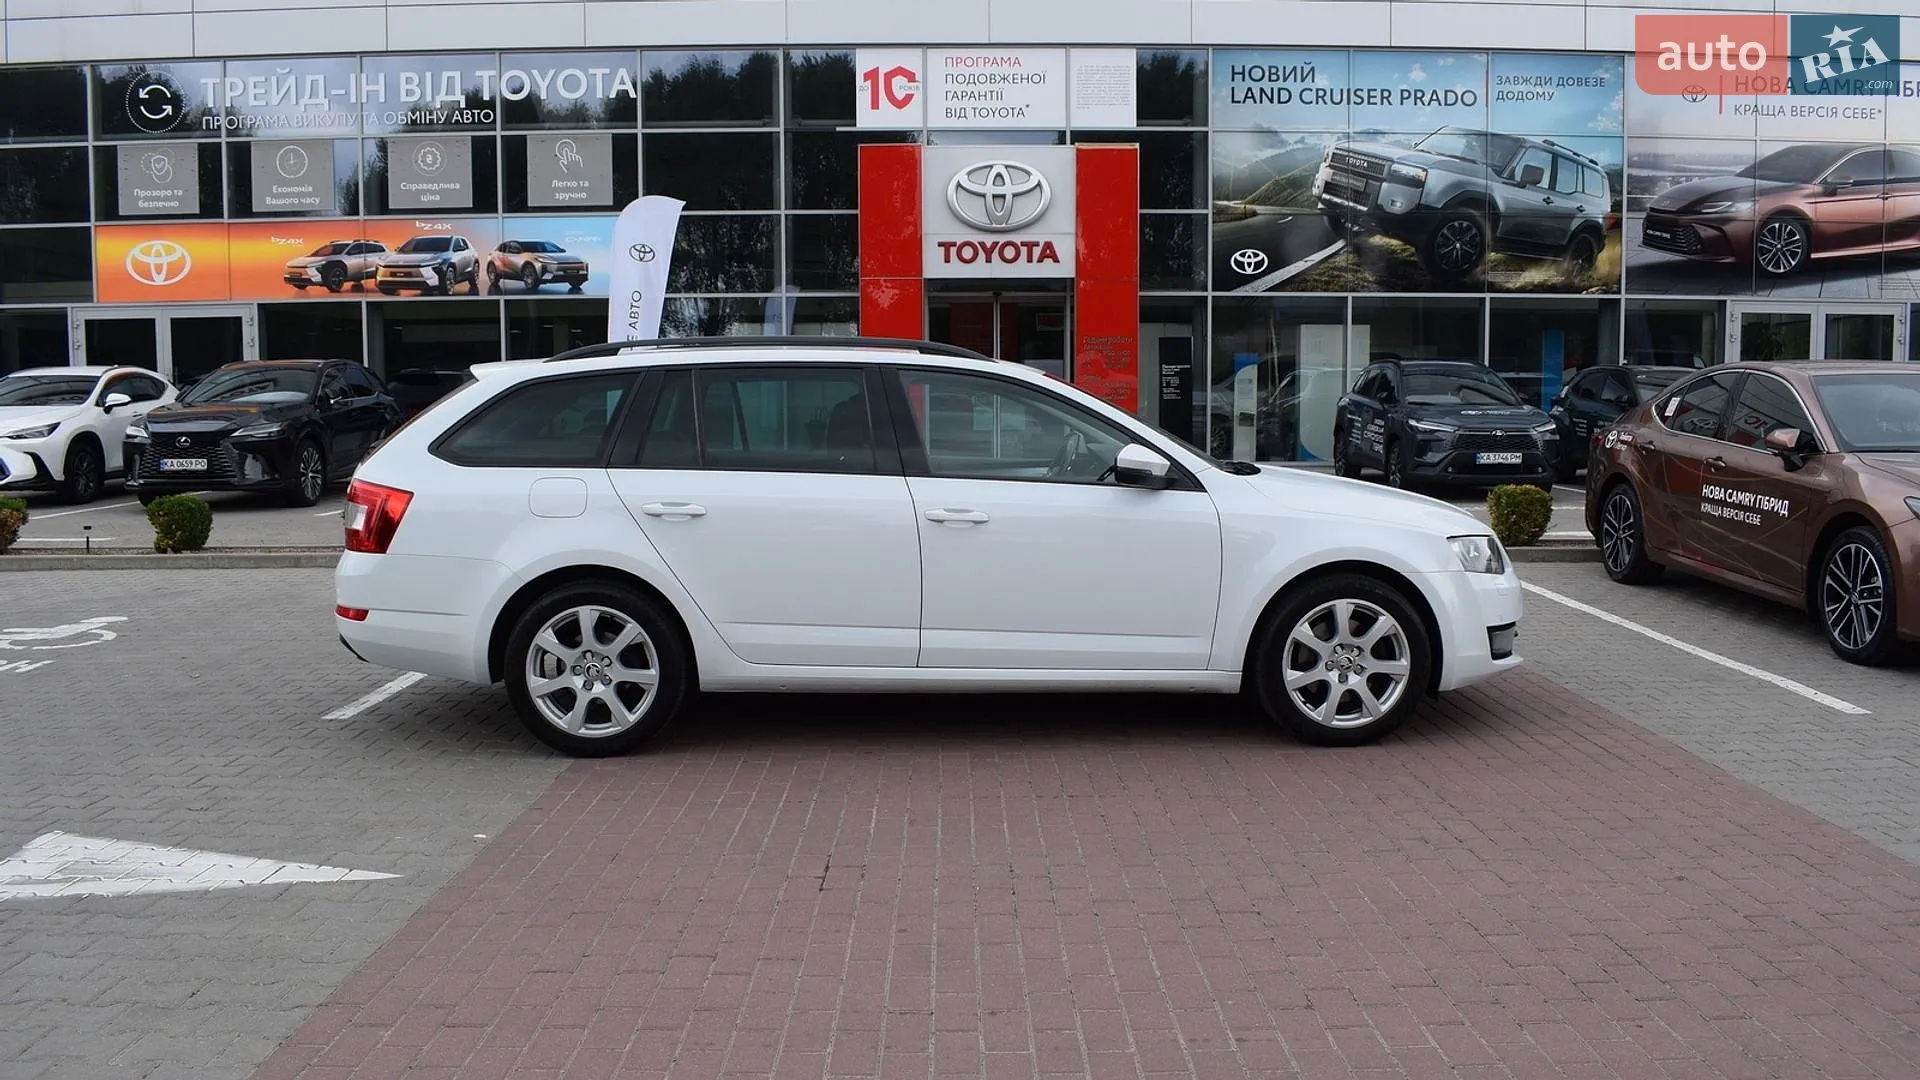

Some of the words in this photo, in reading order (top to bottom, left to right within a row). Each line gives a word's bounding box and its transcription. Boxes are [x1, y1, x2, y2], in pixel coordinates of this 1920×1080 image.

[944, 56, 1022, 68] ПРОГРАМА
[944, 70, 1047, 86] ПОДОВЖЕНОЇ
[1230, 61, 1316, 84] НОВИЙ
[1495, 75, 1554, 89] ЗАВЖДИ
[1556, 75, 1606, 89] ДОВЕЗЕ
[201, 67, 386, 112] ТРЕЙД-ІН
[399, 70, 466, 108] ВІД
[475, 67, 637, 101] TOYOTA
[945, 88, 1004, 102] ГАРАНТІЇ
[1495, 88, 1555, 102] ДОДОМУ
[1230, 86, 1293, 106] LAND
[1299, 87, 1393, 107] CRUISER
[1400, 89, 1478, 108] PRADO
[945, 107, 968, 120] ВІД
[1734, 104, 1786, 119] КРАЩА
[1790, 105, 1838, 118] ВЕРСІЯ
[202, 114, 289, 130] ПРОГРАМА
[294, 112, 354, 129] ВИКУПУ
[360, 111, 379, 126] ТА
[384, 110, 448, 126] ОБМІНУ
[450, 109, 495, 125] АВТО
[272, 185, 313, 194] Економія
[400, 182, 461, 192] Справедлива
[551, 179, 577, 189] Легко
[578, 180, 590, 188] та
[134, 188, 173, 199] Прозоро
[173, 189, 183, 197] та
[420, 192, 441, 203] ціна
[554, 191, 587, 201] зручно
[138, 199, 179, 208] безпечно
[937, 240, 1060, 264] TOYOTA
[1702, 484, 1726, 501] НОВА
[1725, 488, 1757, 507] CAMRY
[1757, 494, 1789, 518] ГІБРИД
[1744, 512, 1762, 526] СЕБЕ
